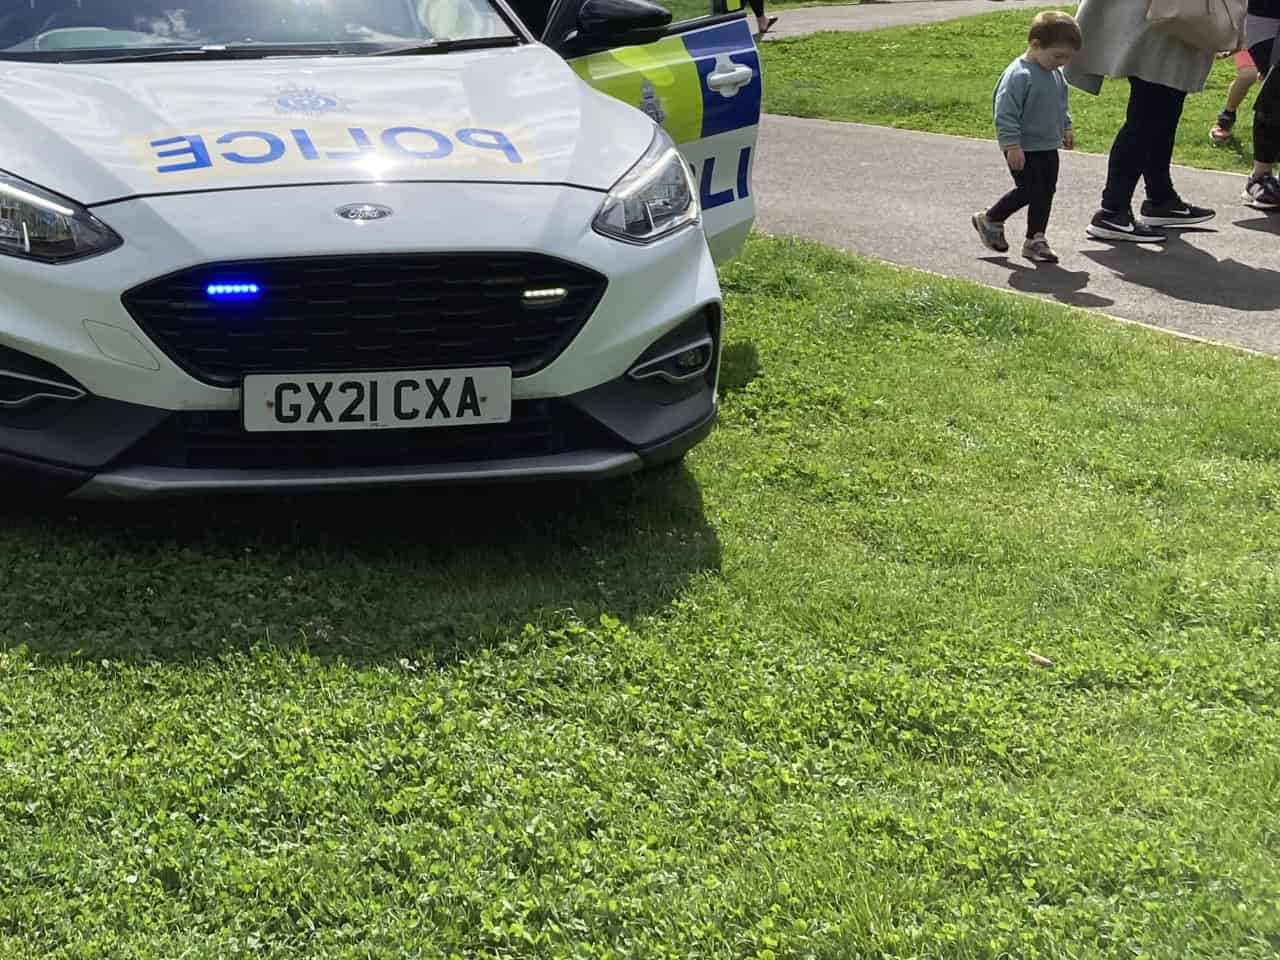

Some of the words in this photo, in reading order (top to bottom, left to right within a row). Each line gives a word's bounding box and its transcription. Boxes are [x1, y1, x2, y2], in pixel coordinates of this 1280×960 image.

[691, 146, 751, 211] LI
[274, 380, 378, 424] GX21
[393, 376, 481, 420] CXA
